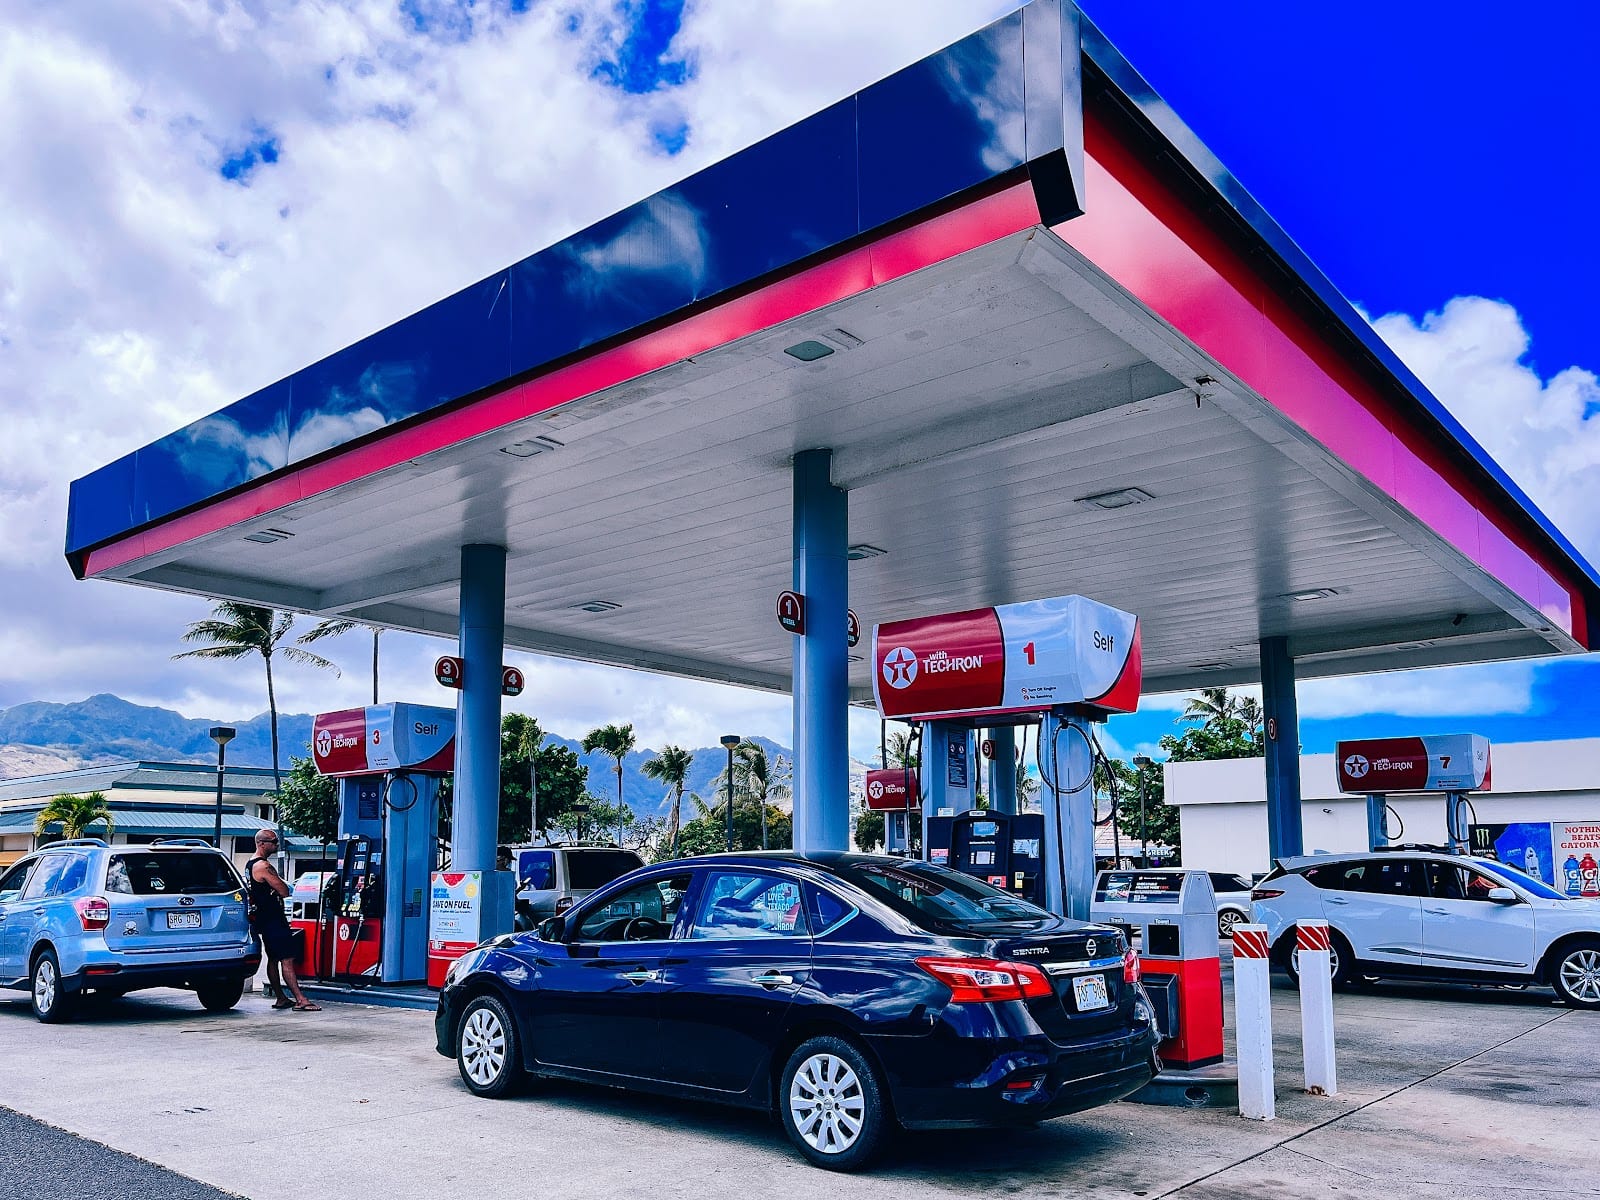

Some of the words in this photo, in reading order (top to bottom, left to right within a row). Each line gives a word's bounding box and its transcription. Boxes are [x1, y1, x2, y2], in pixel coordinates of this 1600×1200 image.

[786, 599, 792, 615] 1
[848, 616, 854, 632] 2
[1093, 630, 1114, 653] Self
[929, 650, 948, 660] with
[1023, 641, 1036, 666] 1
[442, 662, 452, 675] 3
[922, 655, 984, 674] TECHRON
[508, 673, 517, 685] 4
[414, 722, 439, 736] Self
[333, 737, 358, 749] TECHRON
[372, 730, 381, 745] 3
[984, 744, 990, 752] 5
[1371, 761, 1413, 772] TECHRON
[1439, 756, 1451, 769] 7
[884, 786, 905, 794] TECHRO
[768, 893, 785, 901] LOVES
[444, 900, 454, 909] ON
[454, 900, 473, 910] FUEL.
[169, 914, 183, 924] SRG
[186, 913, 200, 924] 076
[1012, 946, 1050, 956] SENTRA
[1093, 982, 1108, 1001] 906
